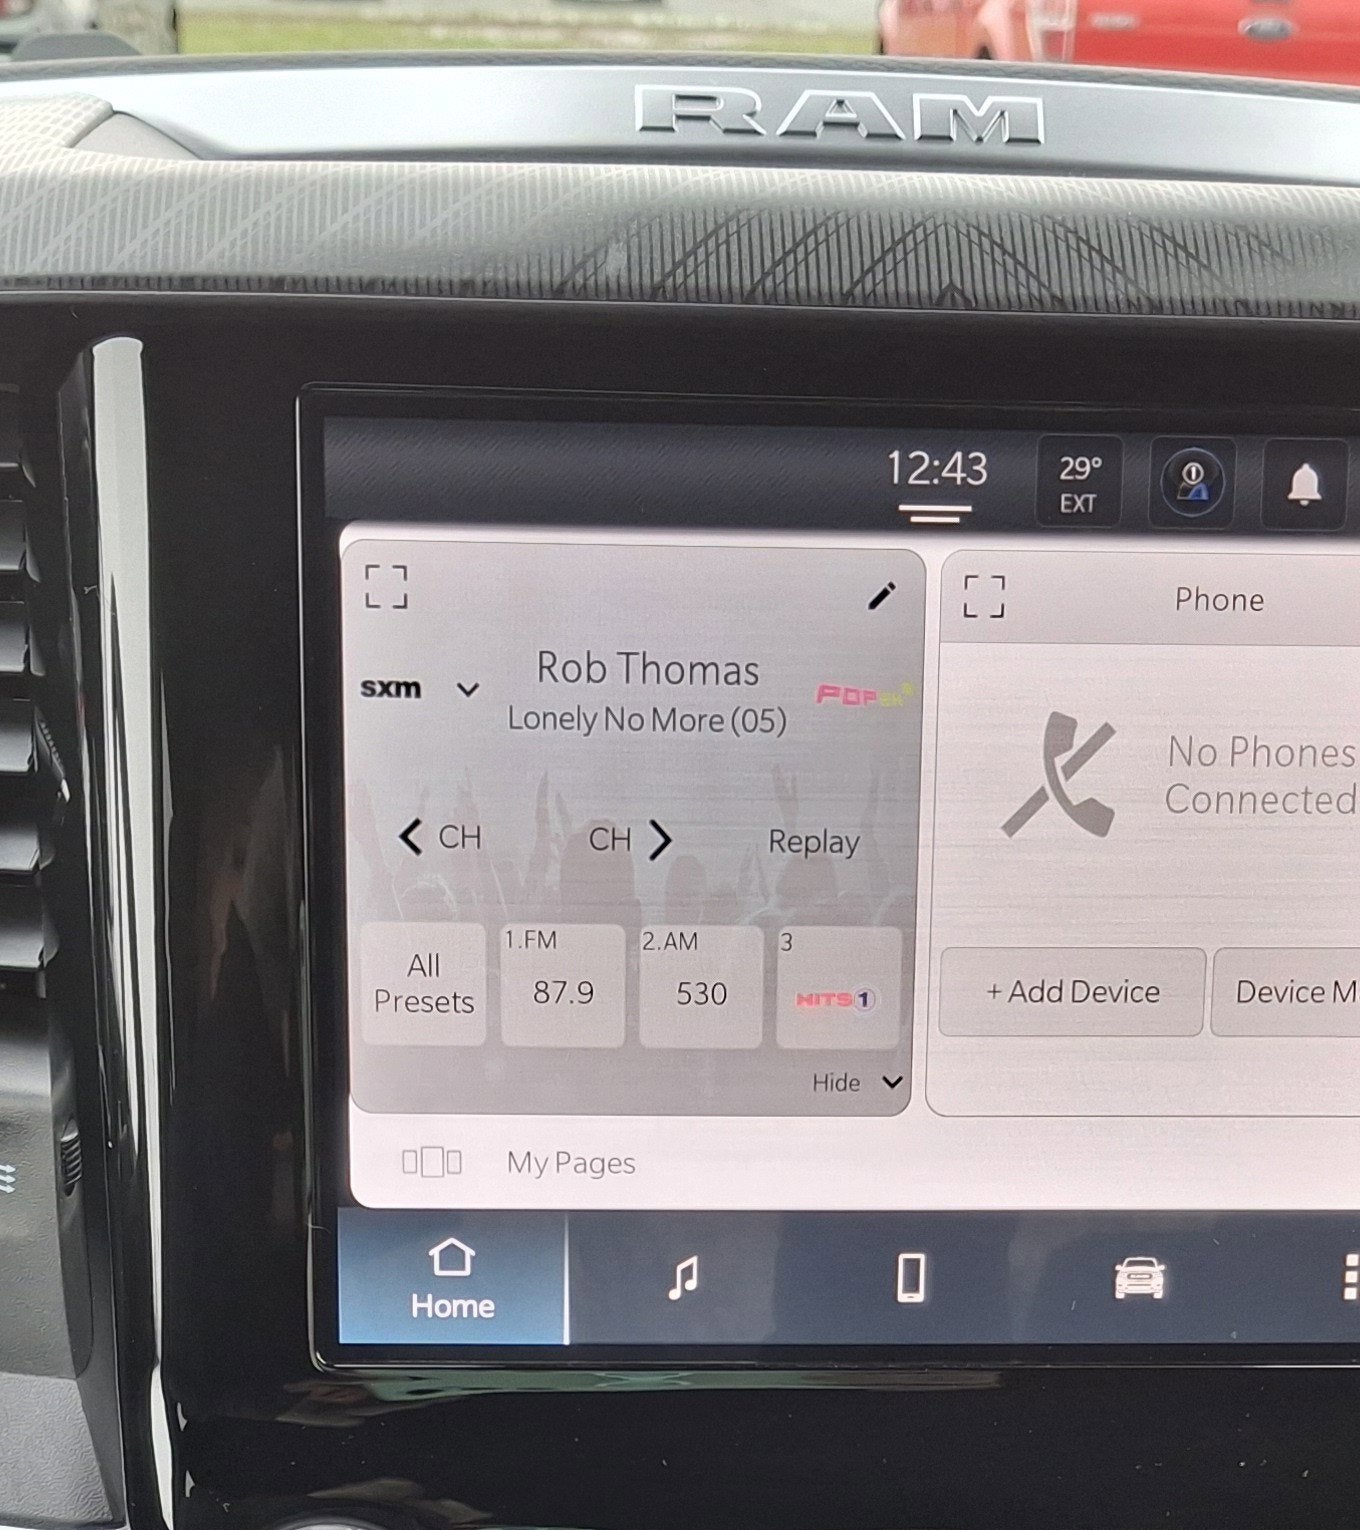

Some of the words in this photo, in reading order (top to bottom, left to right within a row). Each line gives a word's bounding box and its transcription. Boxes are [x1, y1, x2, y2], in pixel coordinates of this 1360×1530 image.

[634, 84, 1046, 144] RAM
[887, 449, 987, 486] 12:43
[1060, 494, 1097, 513] EXT
[1175, 586, 1265, 611] Phone
[539, 650, 607, 684] Rob
[616, 651, 759, 686] Thomas
[360, 678, 421, 698] sxm
[508, 705, 597, 736] Lonely
[605, 708, 645, 732] No
[651, 709, 725, 733] More
[730, 706, 787, 737] (05)
[1169, 735, 1217, 767] No
[1230, 736, 1357, 769] Phones
[1164, 783, 1358, 815] Connected
[439, 825, 482, 850] CH
[589, 827, 631, 852] CH
[769, 828, 861, 859] Replay
[506, 930, 557, 950] 1.FM
[642, 932, 698, 951] 2.AM
[781, 933, 793, 951] 3
[406, 953, 440, 978] All
[375, 989, 475, 1014] Presets
[533, 981, 595, 1005] 87.9
[676, 982, 728, 1006] 530
[1007, 980, 1065, 1004] Add
[1071, 980, 1161, 1004] Device
[1235, 980, 1326, 1004] Device
[814, 1073, 861, 1093] Hide
[507, 1150, 549, 1179] My
[556, 1150, 636, 1180] Pages
[412, 1294, 495, 1318] Home
